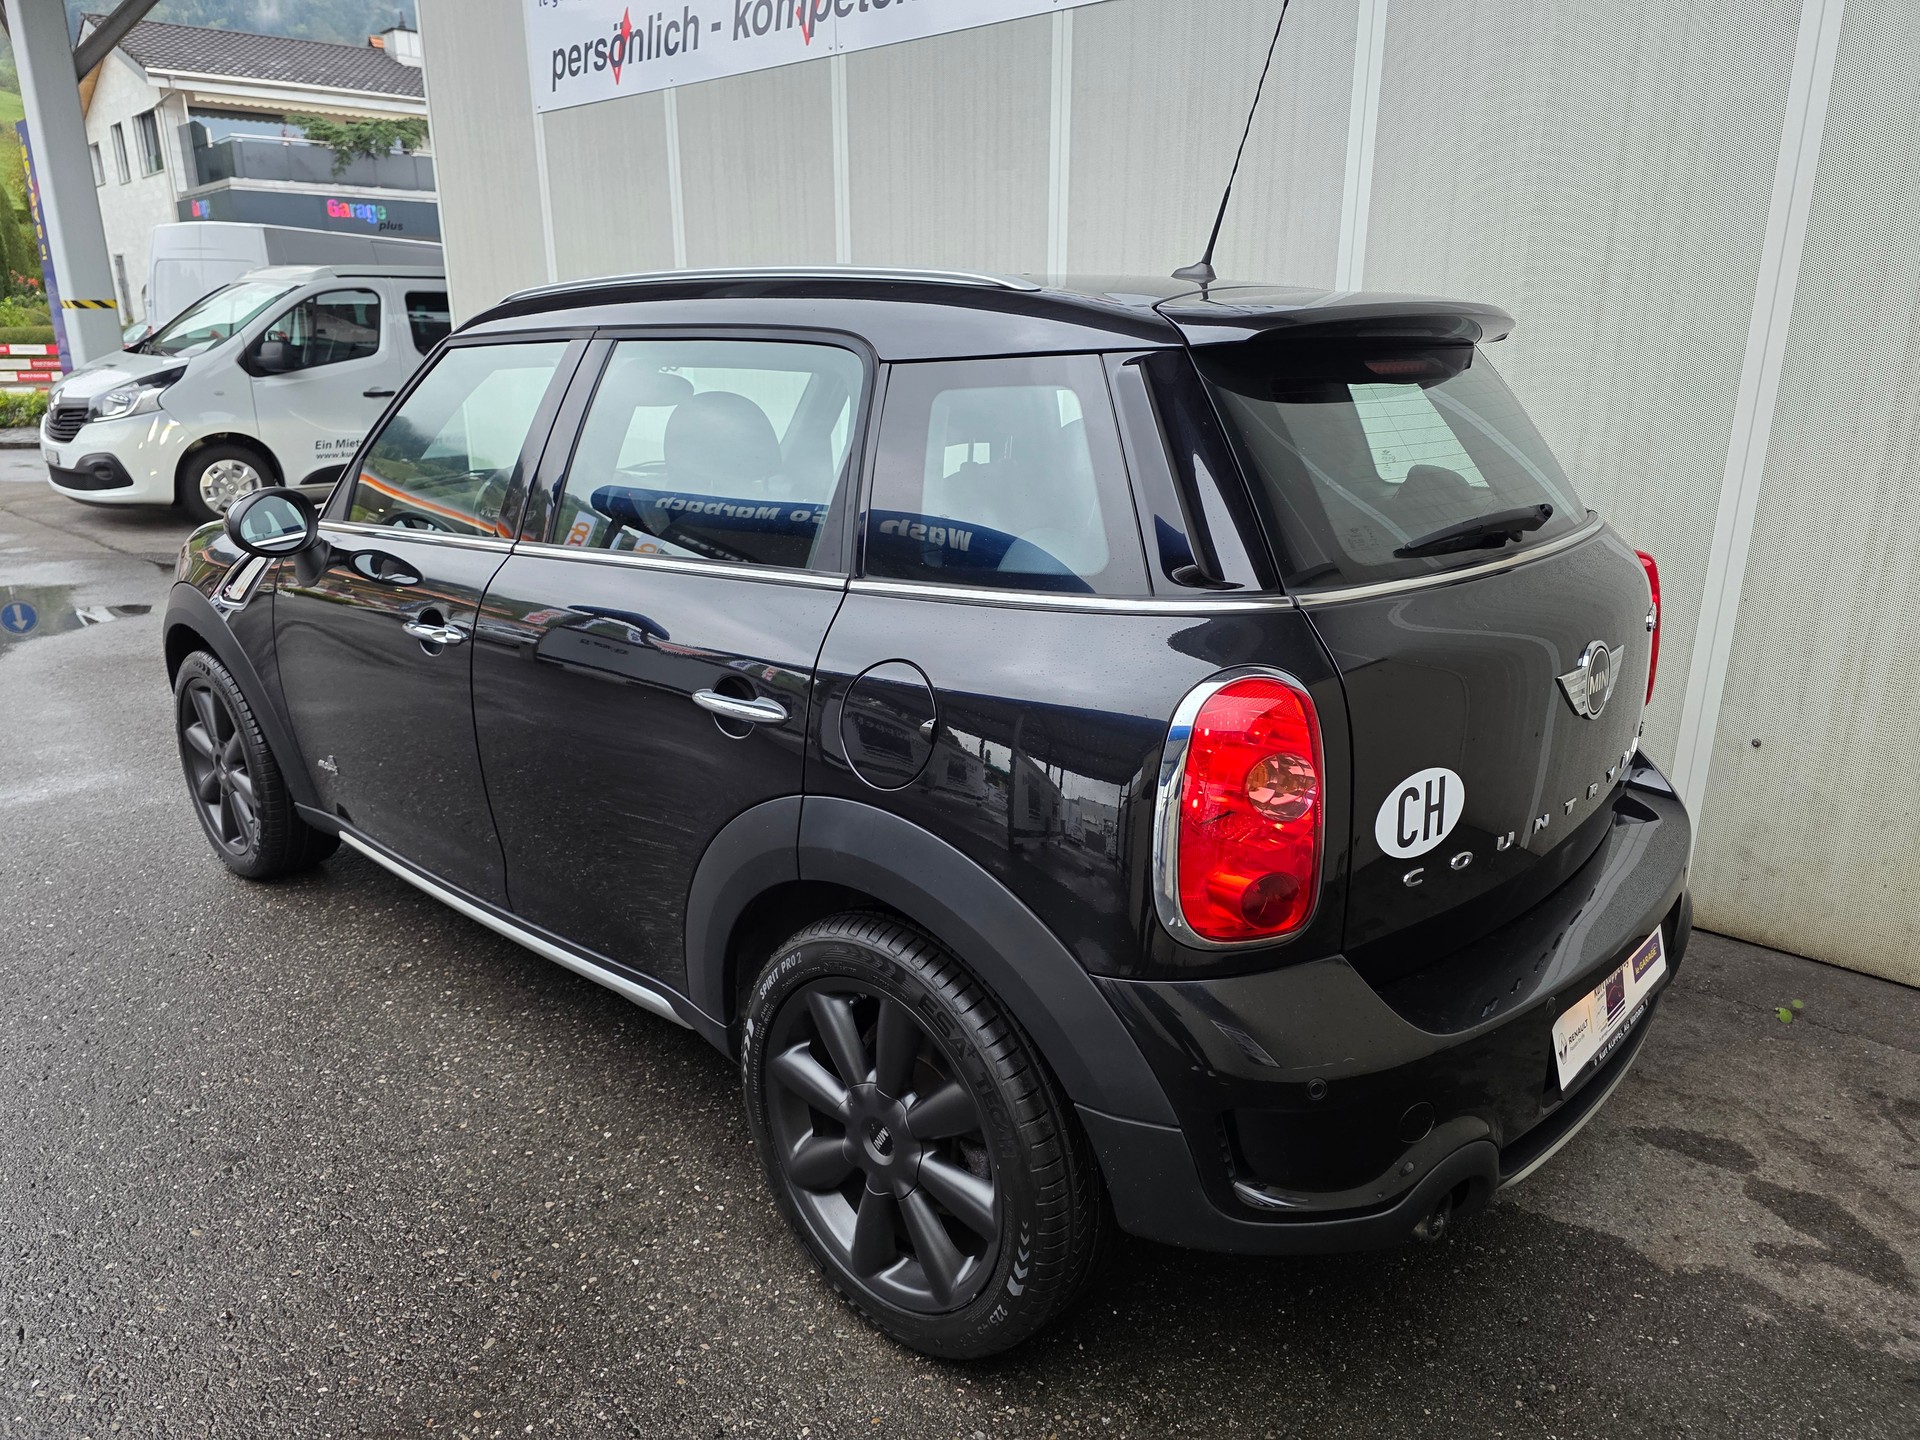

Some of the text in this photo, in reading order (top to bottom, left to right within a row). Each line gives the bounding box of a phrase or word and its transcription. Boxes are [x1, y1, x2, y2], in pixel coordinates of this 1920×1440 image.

[552, 6, 699, 92] persönlich
[327, 199, 386, 224] Garage
[379, 219, 403, 231] plus
[315, 439, 361, 450] Ein Miet
[1588, 671, 1608, 696] MIN
[1397, 775, 1446, 848] CH
[759, 967, 779, 1000] SPIRIT
[781, 954, 796, 973] PRO
[1568, 1018, 1588, 1044] RENAULT
[873, 1127, 889, 1150] MINI
